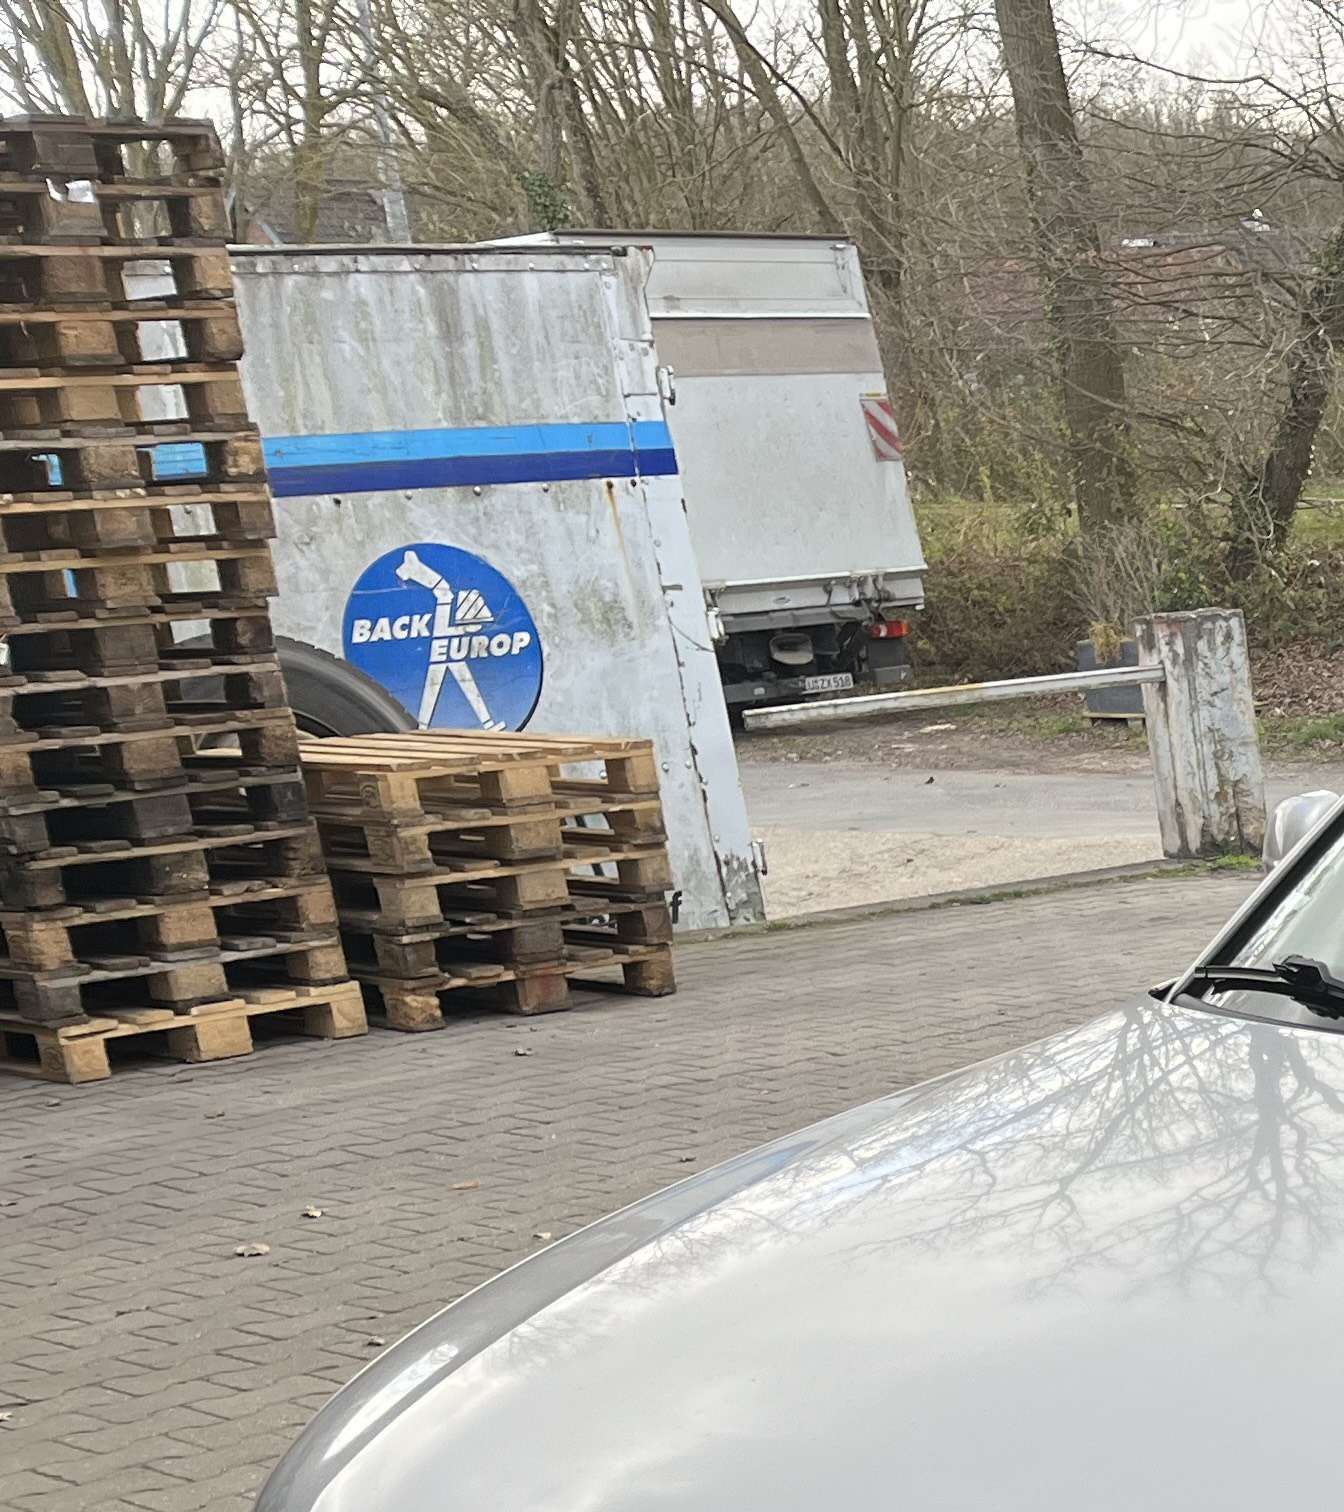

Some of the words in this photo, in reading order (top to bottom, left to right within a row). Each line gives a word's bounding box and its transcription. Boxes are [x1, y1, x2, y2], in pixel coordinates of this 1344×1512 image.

[352, 613, 432, 644] BACK
[429, 631, 531, 663] EUROP
[832, 675, 852, 688] 518
